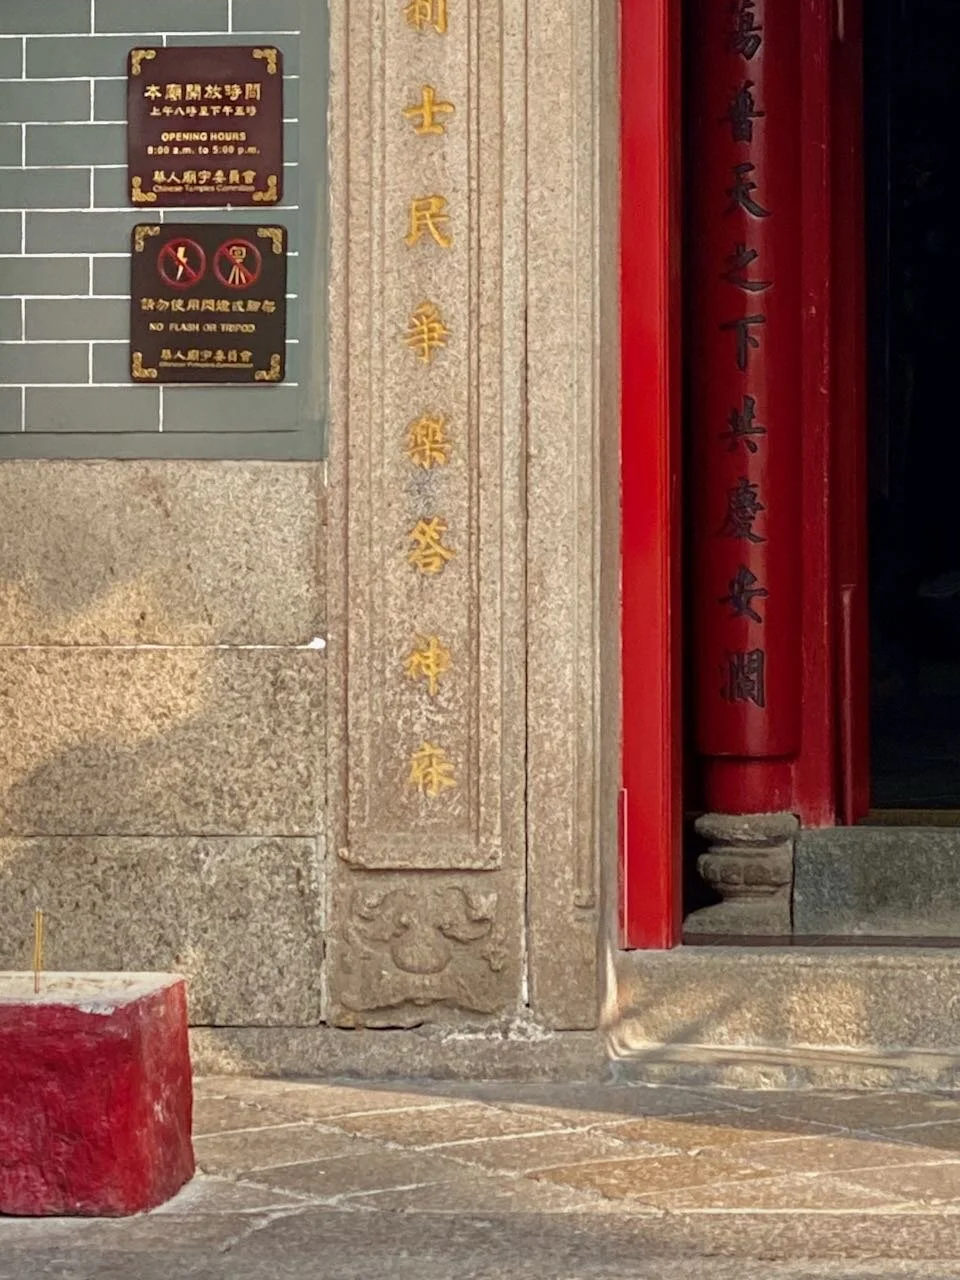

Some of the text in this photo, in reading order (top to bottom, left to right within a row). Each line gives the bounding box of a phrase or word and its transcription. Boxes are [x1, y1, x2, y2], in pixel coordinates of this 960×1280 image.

[144, 83, 261, 101] 本廟開放時間
[150, 106, 257, 117] 上午八時至下午五時
[161, 132, 246, 141] OPENING HOURS
[173, 146, 195, 155] a.m.
[198, 146, 209, 154] to
[212, 145, 235, 154] 5:00
[237, 146, 260, 155] p.m.
[152, 170, 256, 184] 華人廟宇委員會
[149, 323, 256, 332] NO FLASH OR TRIPOD
[160, 349, 253, 362] 華人廟宇委員會
